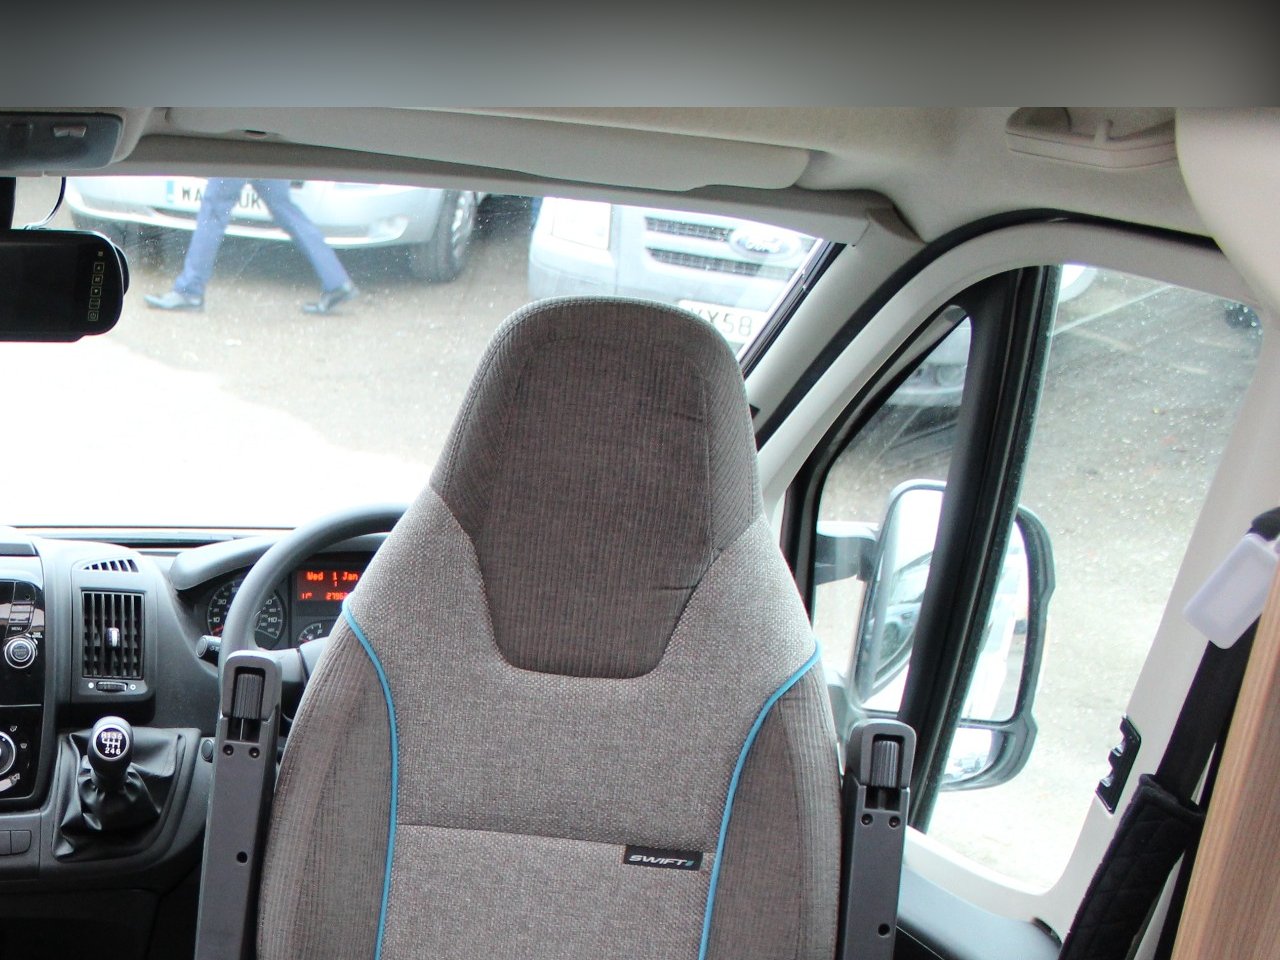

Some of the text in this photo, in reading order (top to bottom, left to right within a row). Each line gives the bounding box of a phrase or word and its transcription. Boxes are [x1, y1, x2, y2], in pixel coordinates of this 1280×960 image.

[307, 571, 324, 581] Wed
[342, 571, 359, 581] Jan
[629, 854, 688, 867] SWIFT
